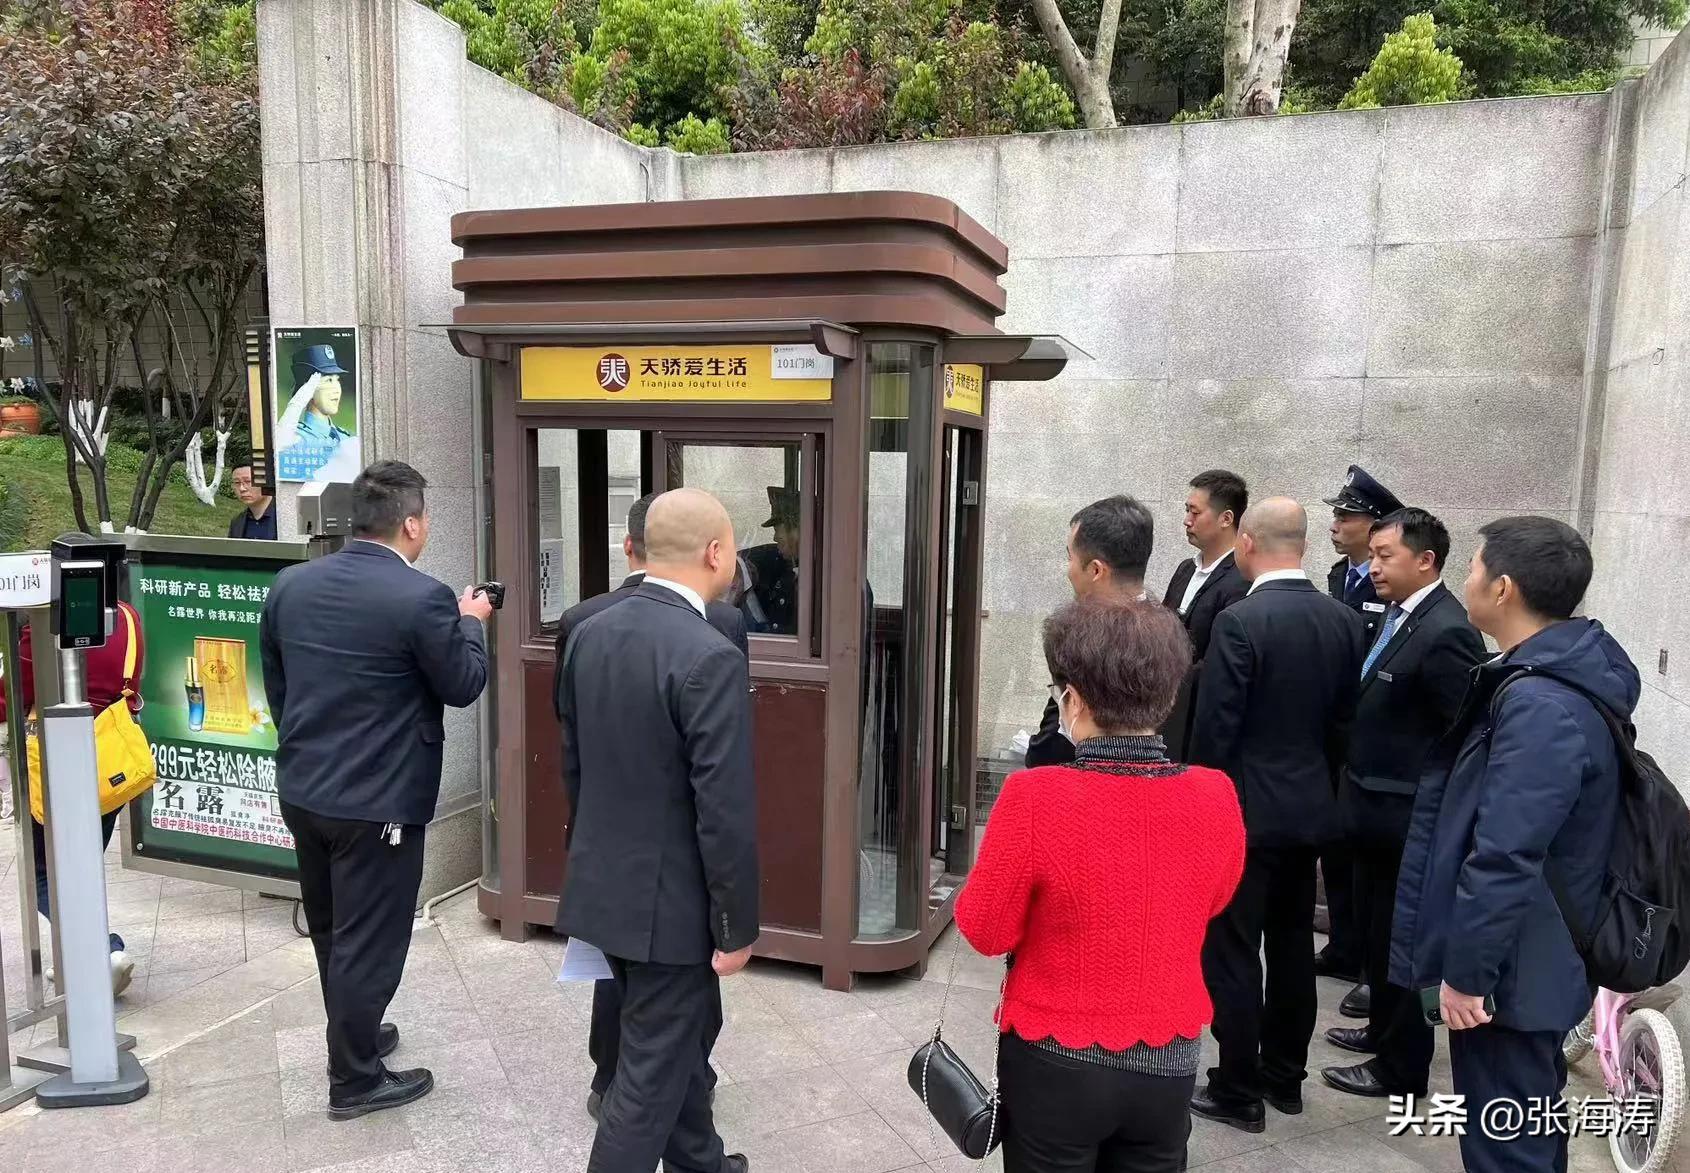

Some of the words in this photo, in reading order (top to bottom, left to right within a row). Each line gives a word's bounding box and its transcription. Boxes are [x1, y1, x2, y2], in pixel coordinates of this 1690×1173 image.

[640, 357, 747, 376] 天骄爱生活
[777, 357, 815, 369] 101门岗
[640, 380, 684, 389] Tianjiao
[688, 380, 722, 389] Joyful
[726, 380, 747, 388] Life
[139, 577, 211, 598] 科研新产品
[167, 605, 205, 619] 名露世界
[159, 780, 224, 815] 名露
